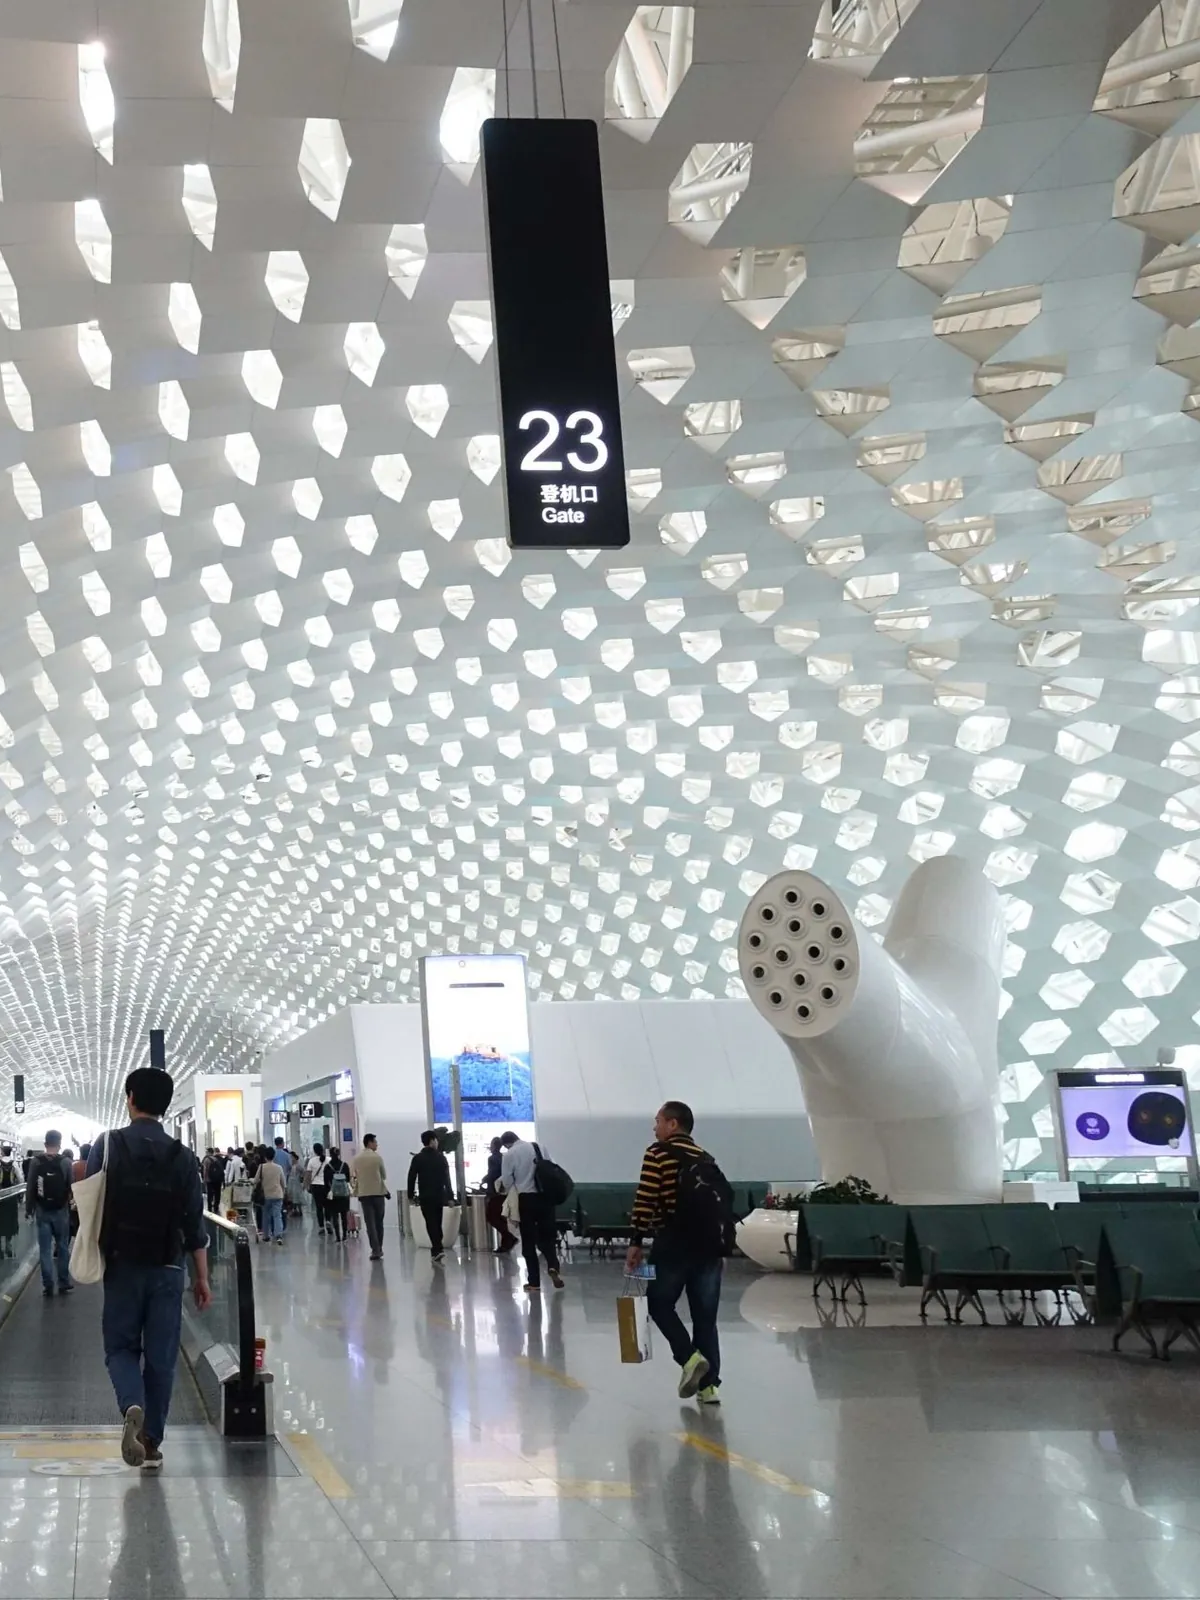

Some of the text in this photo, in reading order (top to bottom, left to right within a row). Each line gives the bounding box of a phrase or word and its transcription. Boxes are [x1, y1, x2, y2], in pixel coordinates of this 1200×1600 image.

[518, 410, 608, 472] 23
[540, 484, 598, 503] 登机口
[541, 507, 585, 524] Gate
